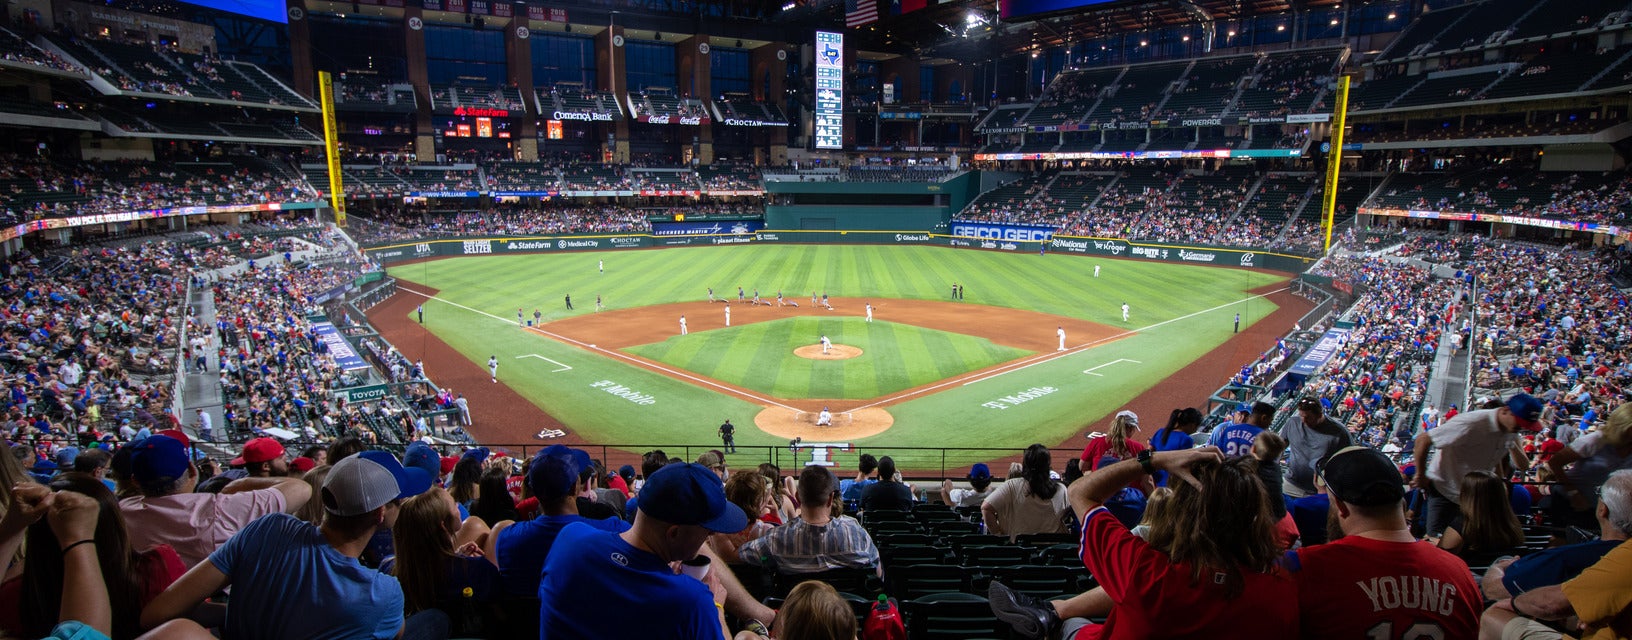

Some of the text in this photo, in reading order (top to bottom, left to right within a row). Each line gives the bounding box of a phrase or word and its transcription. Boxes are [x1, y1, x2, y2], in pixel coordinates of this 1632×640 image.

[290, 9, 301, 18] 42
[410, 18, 421, 27] 34
[592, 112, 613, 121] Bank
[729, 118, 762, 126] CHOCTAW
[1182, 118, 1221, 127] POWERADE
[66, 217, 81, 226] YOU
[82, 216, 95, 225] PICK
[104, 214, 117, 223] YOU
[117, 213, 132, 222] HEAR
[1502, 215, 1513, 223] YOU
[1514, 216, 1523, 224] PICK
[1530, 218, 1540, 226] YOU
[1540, 219, 1553, 227] HEAR
[953, 226, 1052, 242] GEICO GEICO
[415, 243, 431, 253] UTA
[567, 240, 598, 248] Medical City
[1060, 240, 1088, 250] National
[463, 244, 492, 255] SELTZER
[1188, 251, 1215, 260] Germania
[351, 388, 386, 400] TOYOTA
[1227, 429, 1257, 444] BELTRE
[1356, 575, 1457, 616] YOUNG
